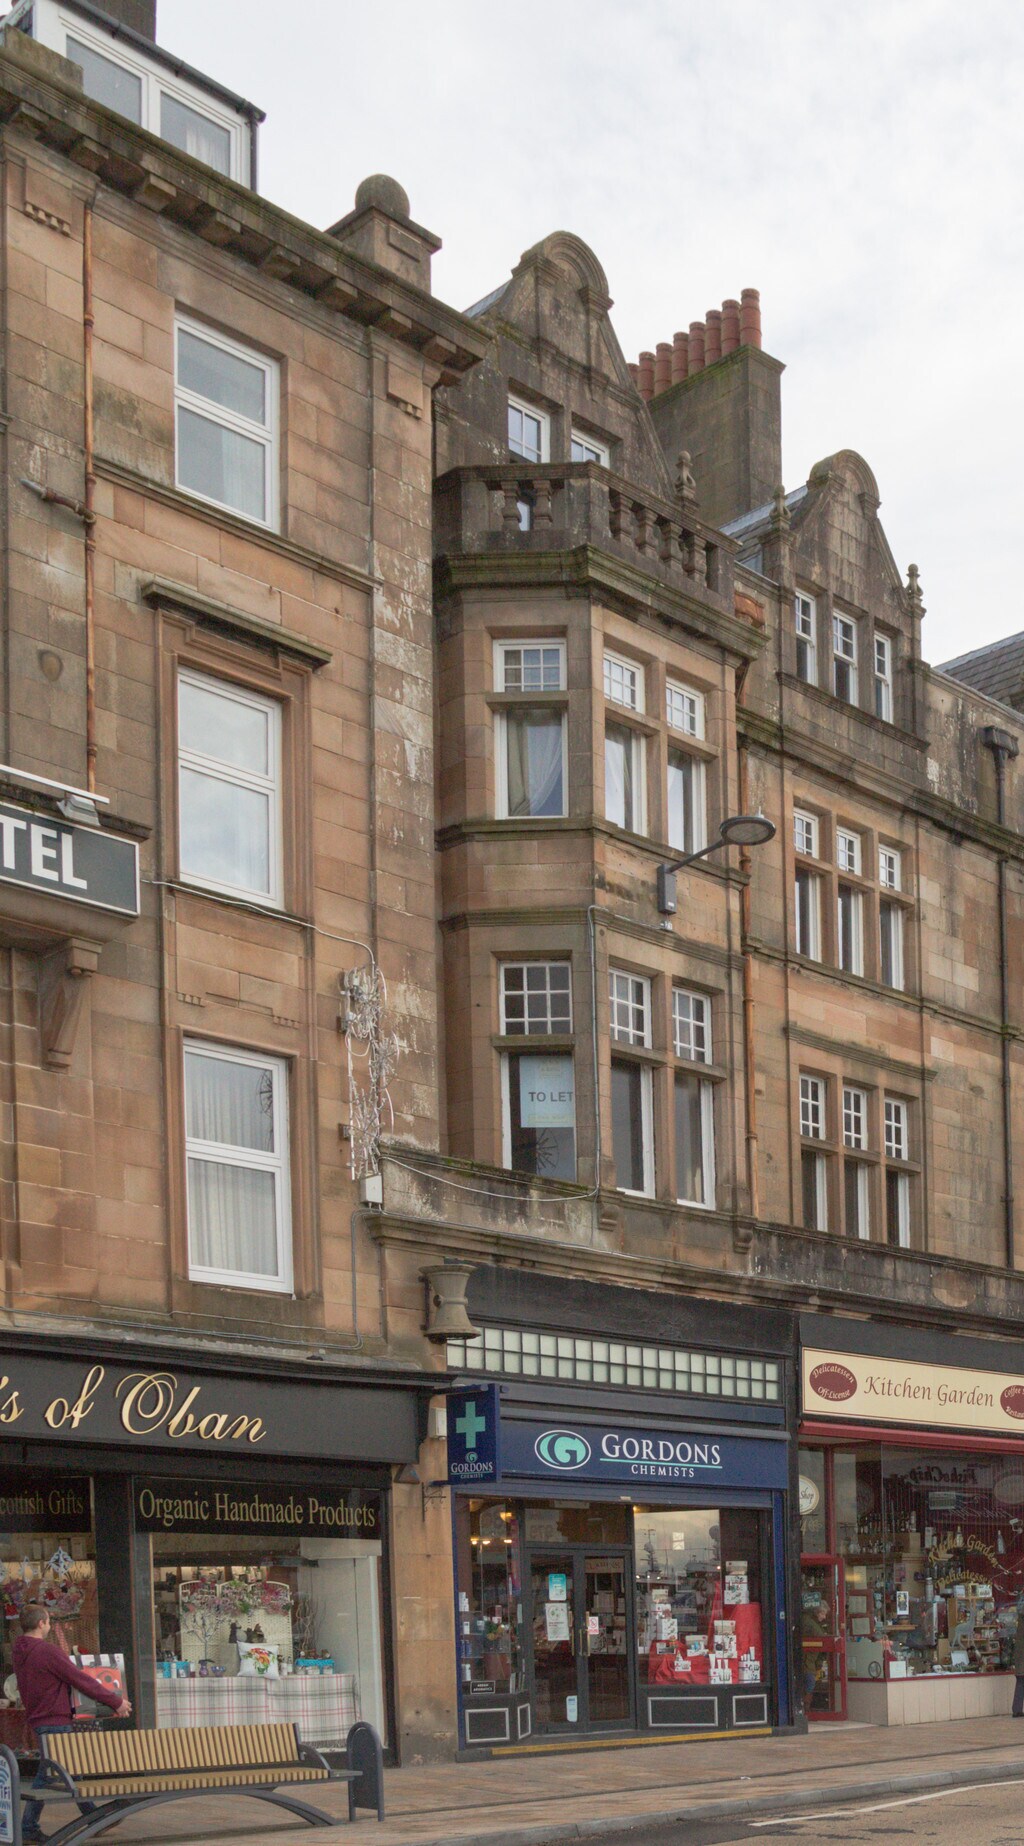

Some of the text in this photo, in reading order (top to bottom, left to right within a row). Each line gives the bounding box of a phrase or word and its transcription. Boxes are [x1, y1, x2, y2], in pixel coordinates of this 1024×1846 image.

[528, 1092, 574, 1102] TO LET
[812, 1364, 856, 1384] Delicatessen
[44, 1365, 105, 1429] of
[115, 1371, 267, 1444] Oban
[863, 1375, 994, 1407] Kitchen Garden
[1003, 1386, 1021, 1398] Coffee
[601, 1433, 721, 1465] GORDONS
[451, 1462, 493, 1473] GORDONS
[631, 1464, 695, 1478] CHEMISTS
[48, 1488, 84, 1515] Gifts
[139, 1489, 376, 1527] Organic Handmade Products
[967, 1534, 998, 1568] Garden
